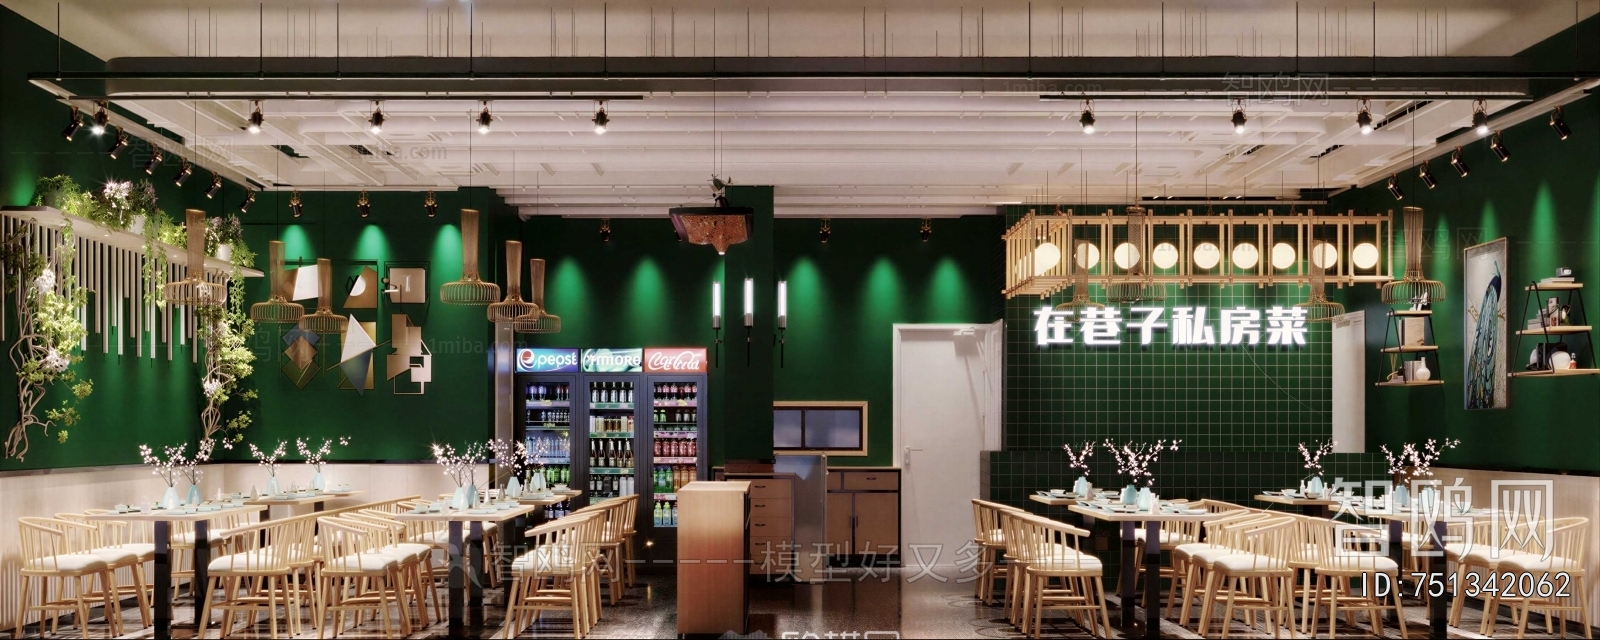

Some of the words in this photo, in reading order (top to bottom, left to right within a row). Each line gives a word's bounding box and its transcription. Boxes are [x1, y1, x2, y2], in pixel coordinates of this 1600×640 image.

[1033, 305, 1308, 346] 在巷子私房菜
